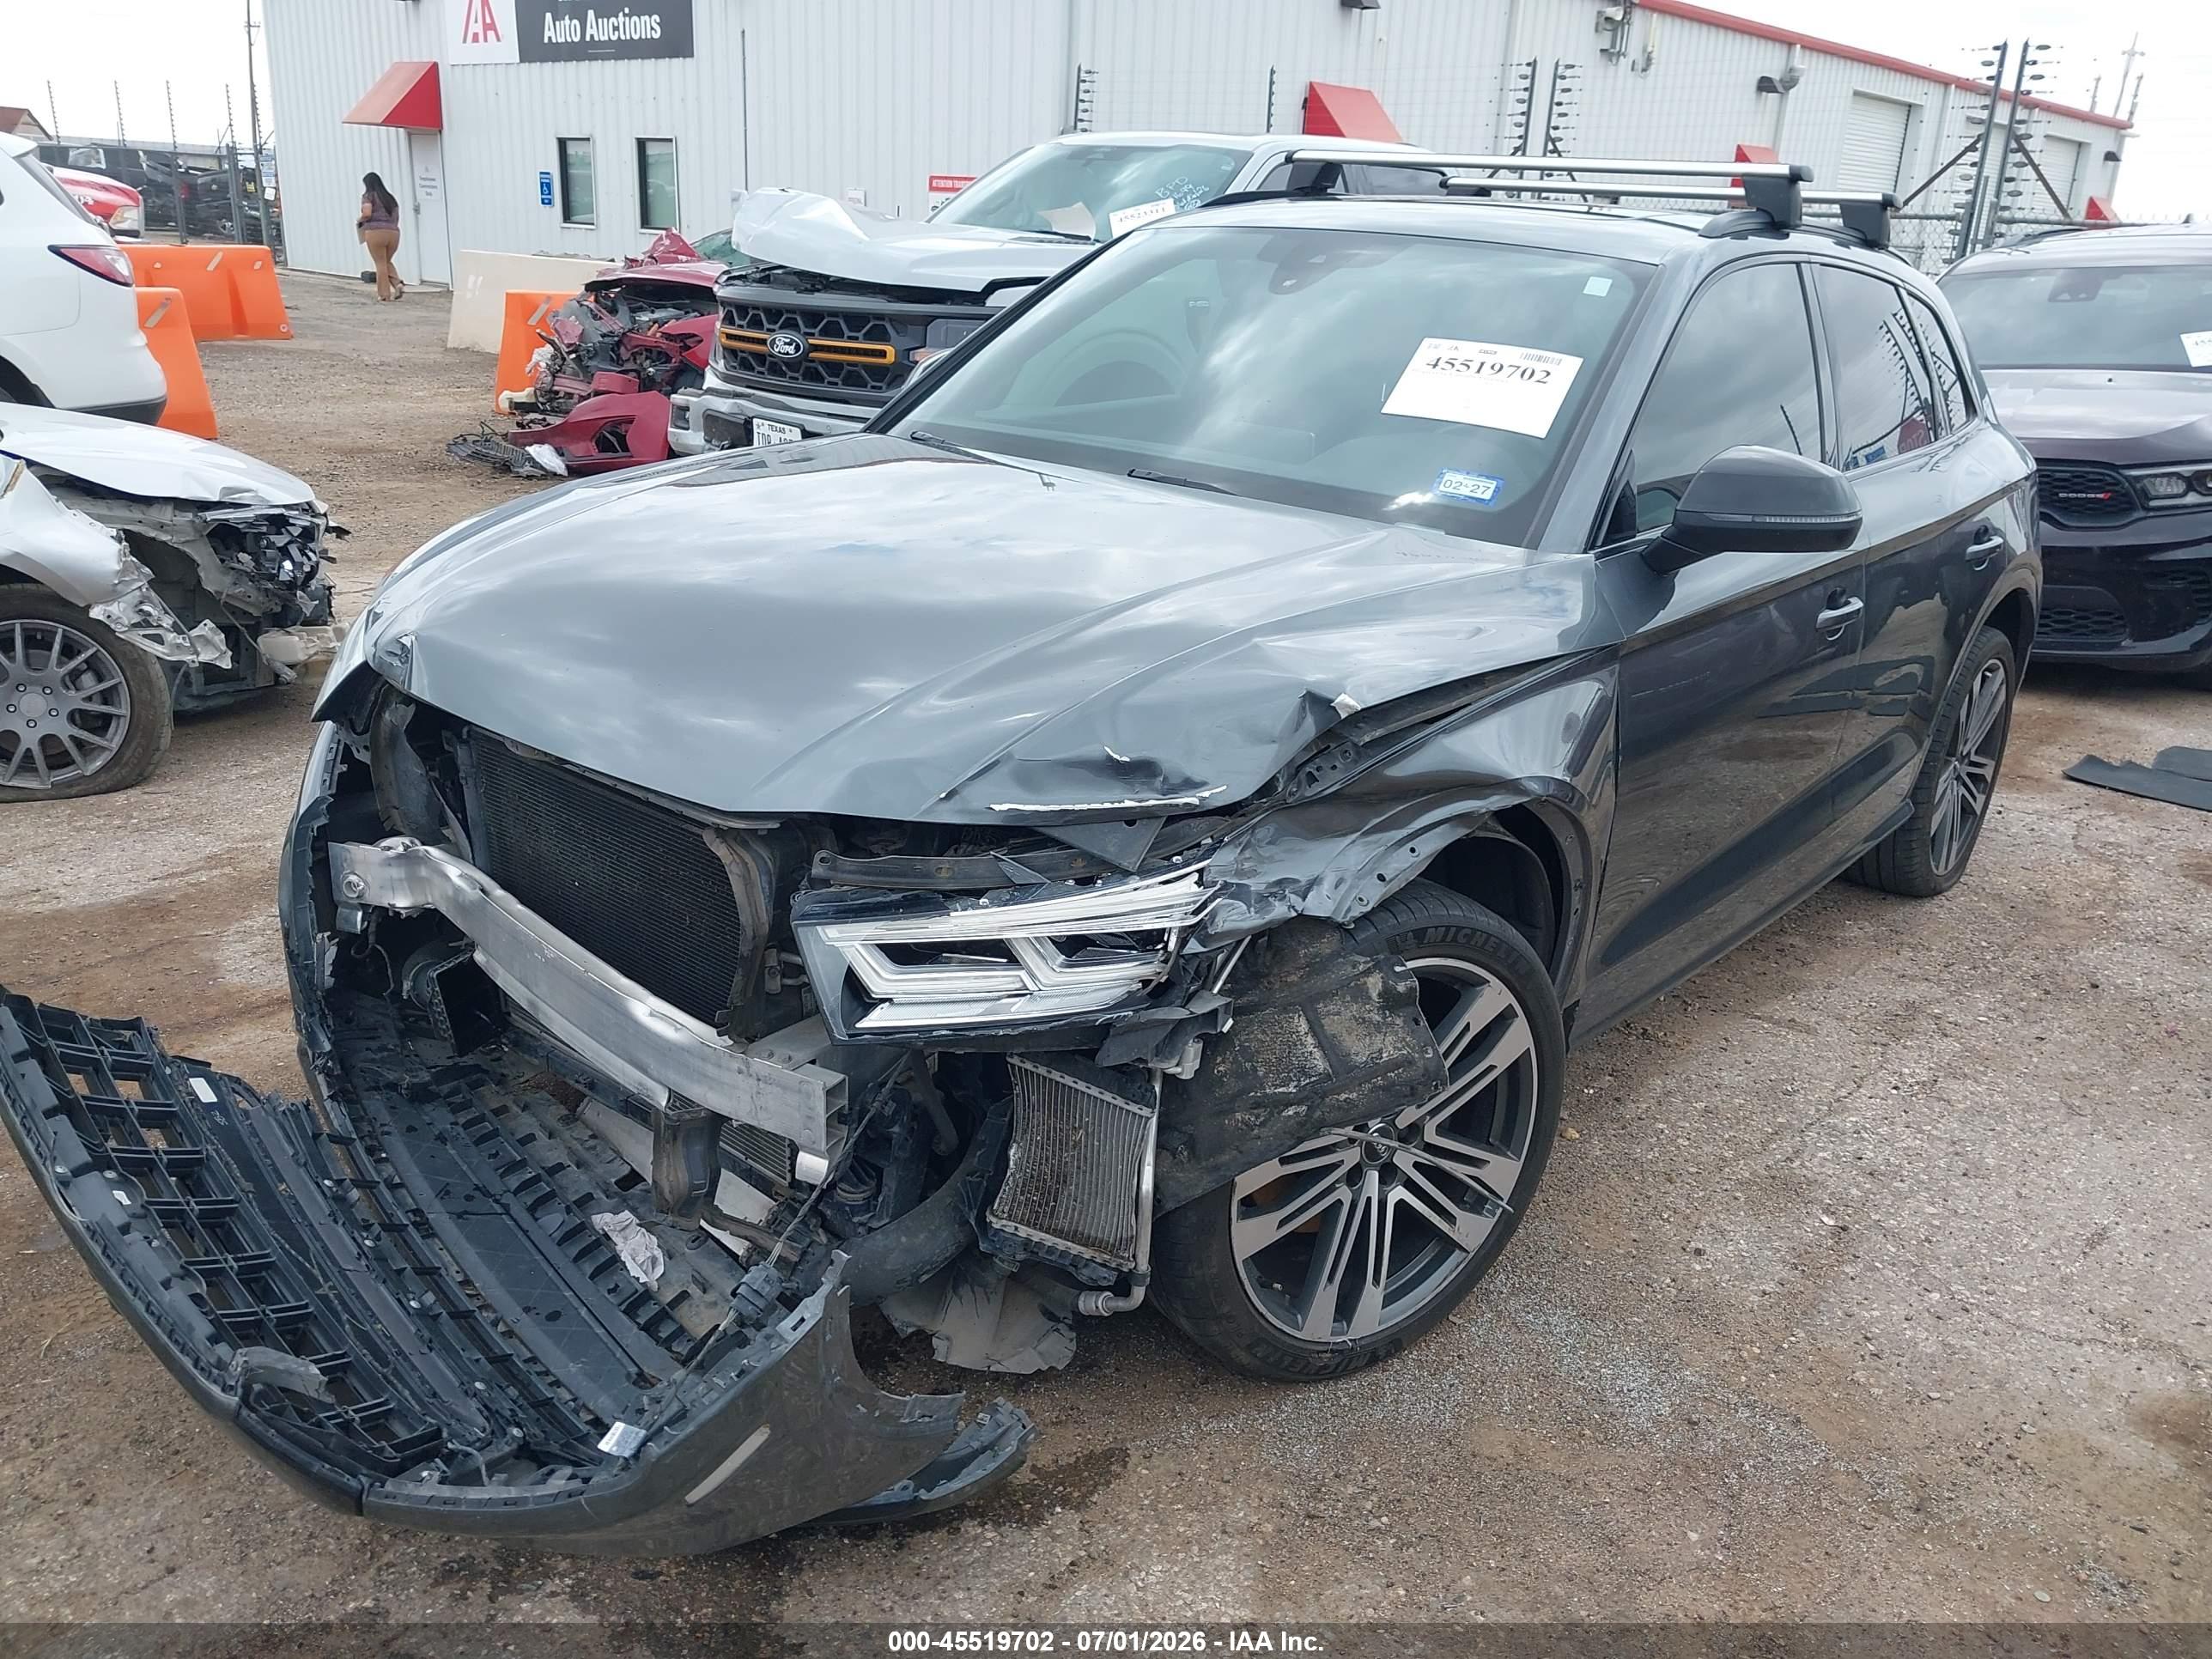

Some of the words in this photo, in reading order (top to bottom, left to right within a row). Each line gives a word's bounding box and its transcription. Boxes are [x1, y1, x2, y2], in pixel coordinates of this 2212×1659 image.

[543, 12, 581, 44] Auto
[585, 7, 662, 42] Auctions
[774, 337, 796, 354] Ford
[1426, 356, 1552, 385] 45519702
[768, 424, 786, 434] TEXAS
